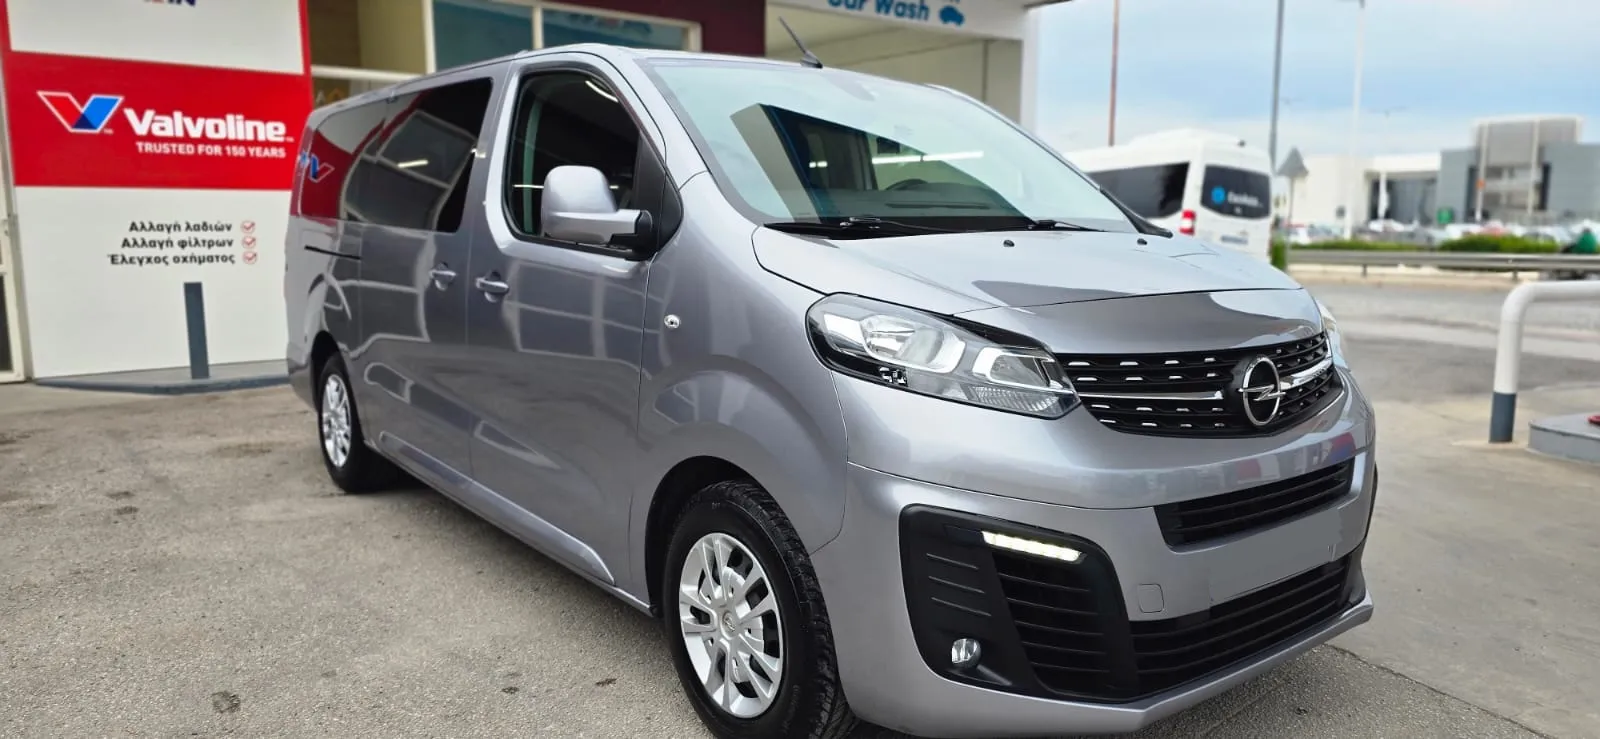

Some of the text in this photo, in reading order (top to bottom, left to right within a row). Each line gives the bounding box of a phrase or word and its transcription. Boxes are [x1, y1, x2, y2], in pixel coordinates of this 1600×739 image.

[874, 0, 930, 21] Wash
[123, 108, 287, 143] Valvoline
[136, 141, 286, 159] TRUSTED FOR 150 YEARS
[129, 220, 233, 235] Αλλαγή λαδιών
[121, 237, 234, 251] Αλλαγή φίλτρων
[108, 252, 236, 267] Έλεγχος οχήματος
